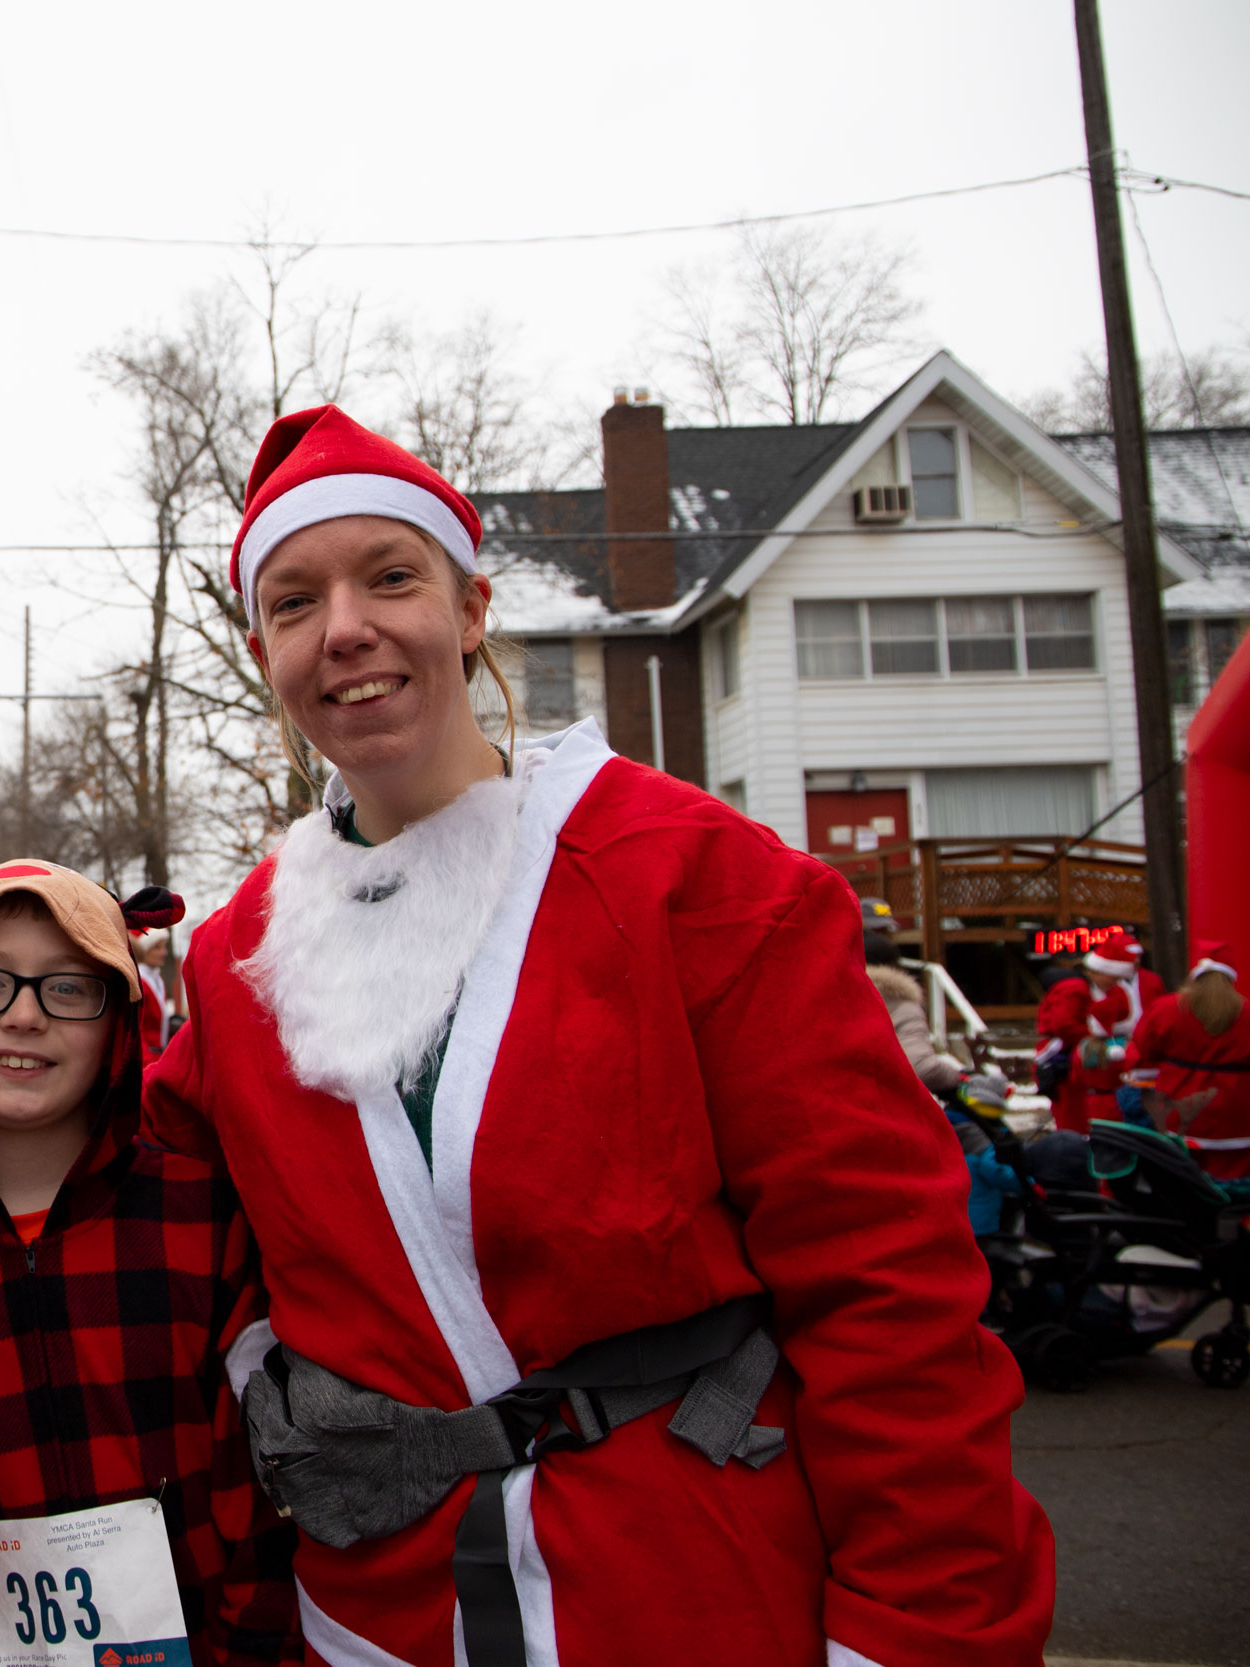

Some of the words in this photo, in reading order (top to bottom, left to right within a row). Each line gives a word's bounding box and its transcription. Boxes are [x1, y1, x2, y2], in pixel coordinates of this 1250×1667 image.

[50, 1523, 74, 1534] YMCA
[75, 1520, 96, 1530] Santa
[98, 1516, 113, 1525] Run
[46, 1533, 81, 1546] presented
[102, 1526, 122, 1535] Serra
[10, 1540, 21, 1551] iD
[66, 1544, 83, 1552] Auto
[84, 1540, 105, 1549] Plaza
[6, 1567, 101, 1644] 363
[126, 1653, 152, 1665] ROAD
[154, 1652, 165, 1662] iD
